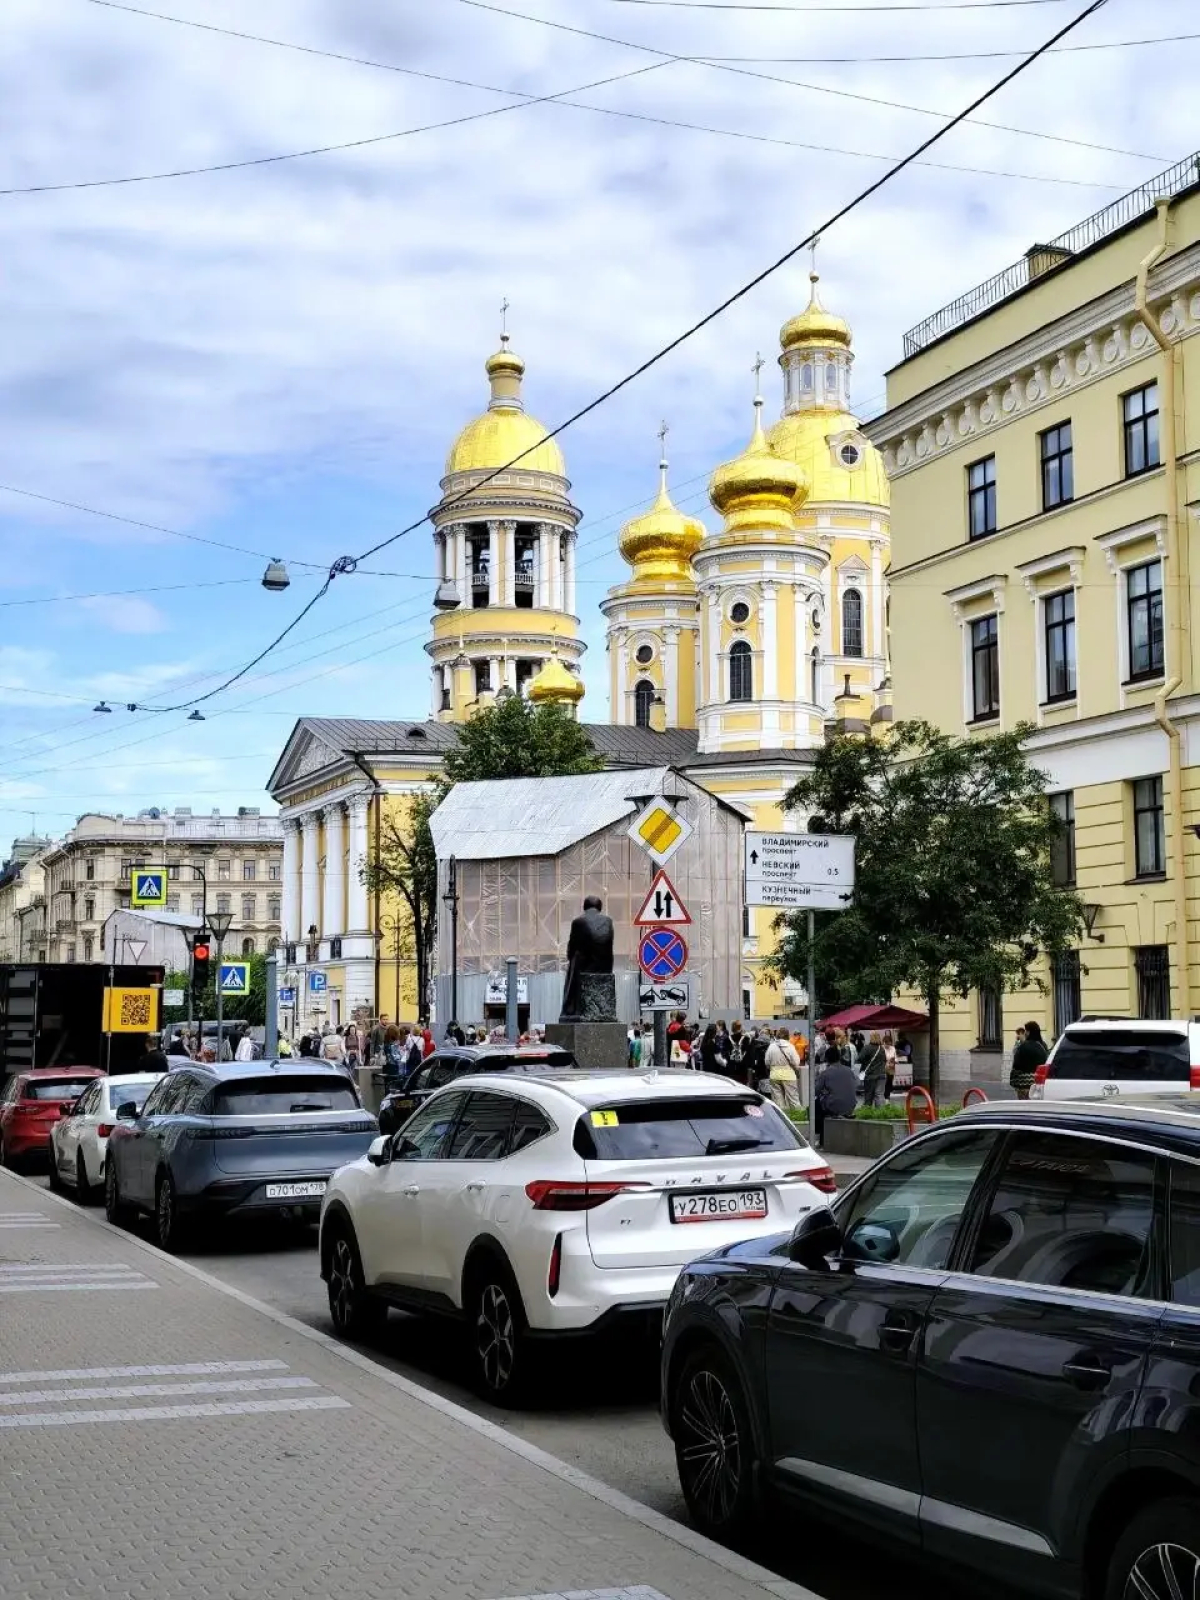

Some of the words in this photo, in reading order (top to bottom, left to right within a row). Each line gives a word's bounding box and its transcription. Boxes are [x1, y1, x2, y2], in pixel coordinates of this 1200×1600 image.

[762, 838, 829, 848] ВЛАДИМИРСКИЙ
[762, 861, 800, 869] НЕВСКИЙ
[827, 868, 839, 876] 0.5
[762, 886, 811, 895] КУЗНЕЧНЫЙ
[665, 1170, 772, 1186] HAVAL
